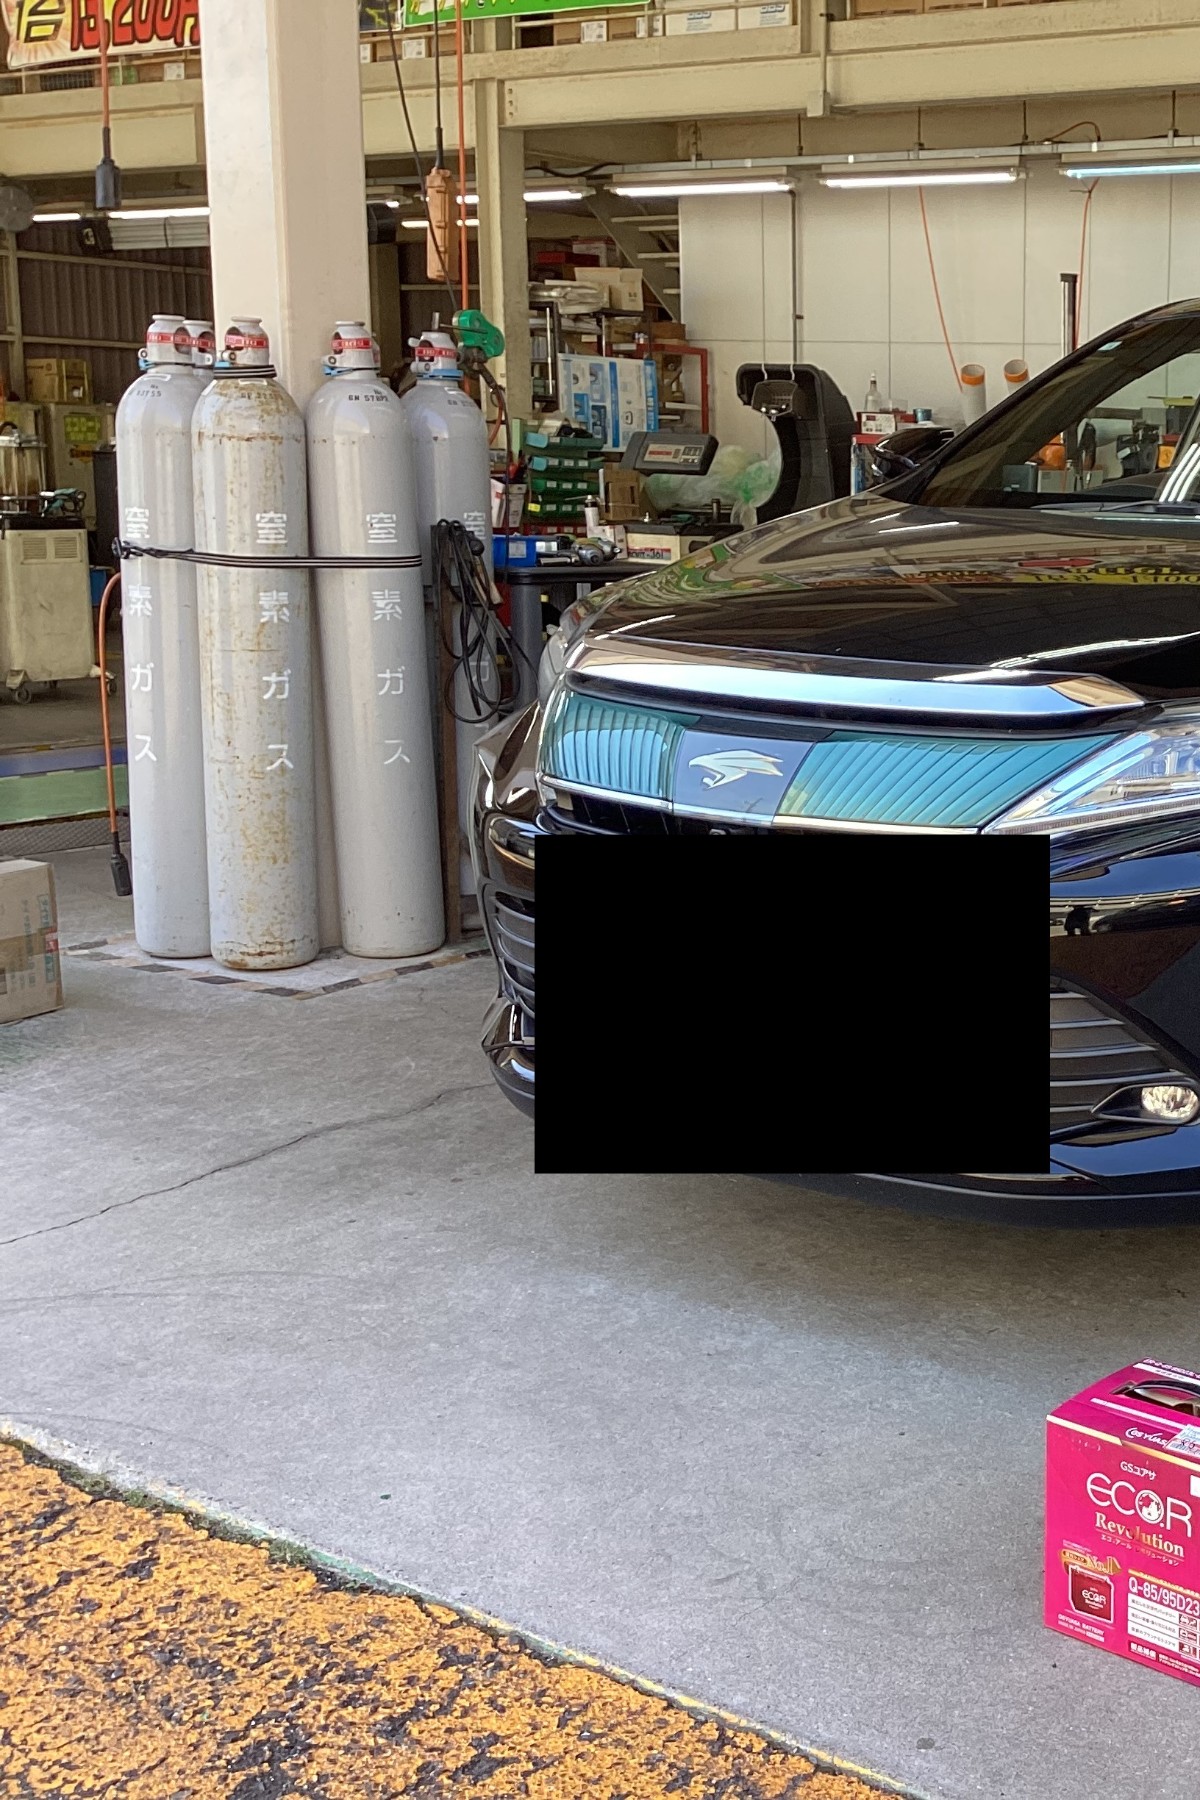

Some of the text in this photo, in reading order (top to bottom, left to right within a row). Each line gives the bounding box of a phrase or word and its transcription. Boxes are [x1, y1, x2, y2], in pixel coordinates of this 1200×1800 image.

[1120, 1460, 1157, 1481] GSユアサ
[1095, 1511, 1185, 1558] Revolution
